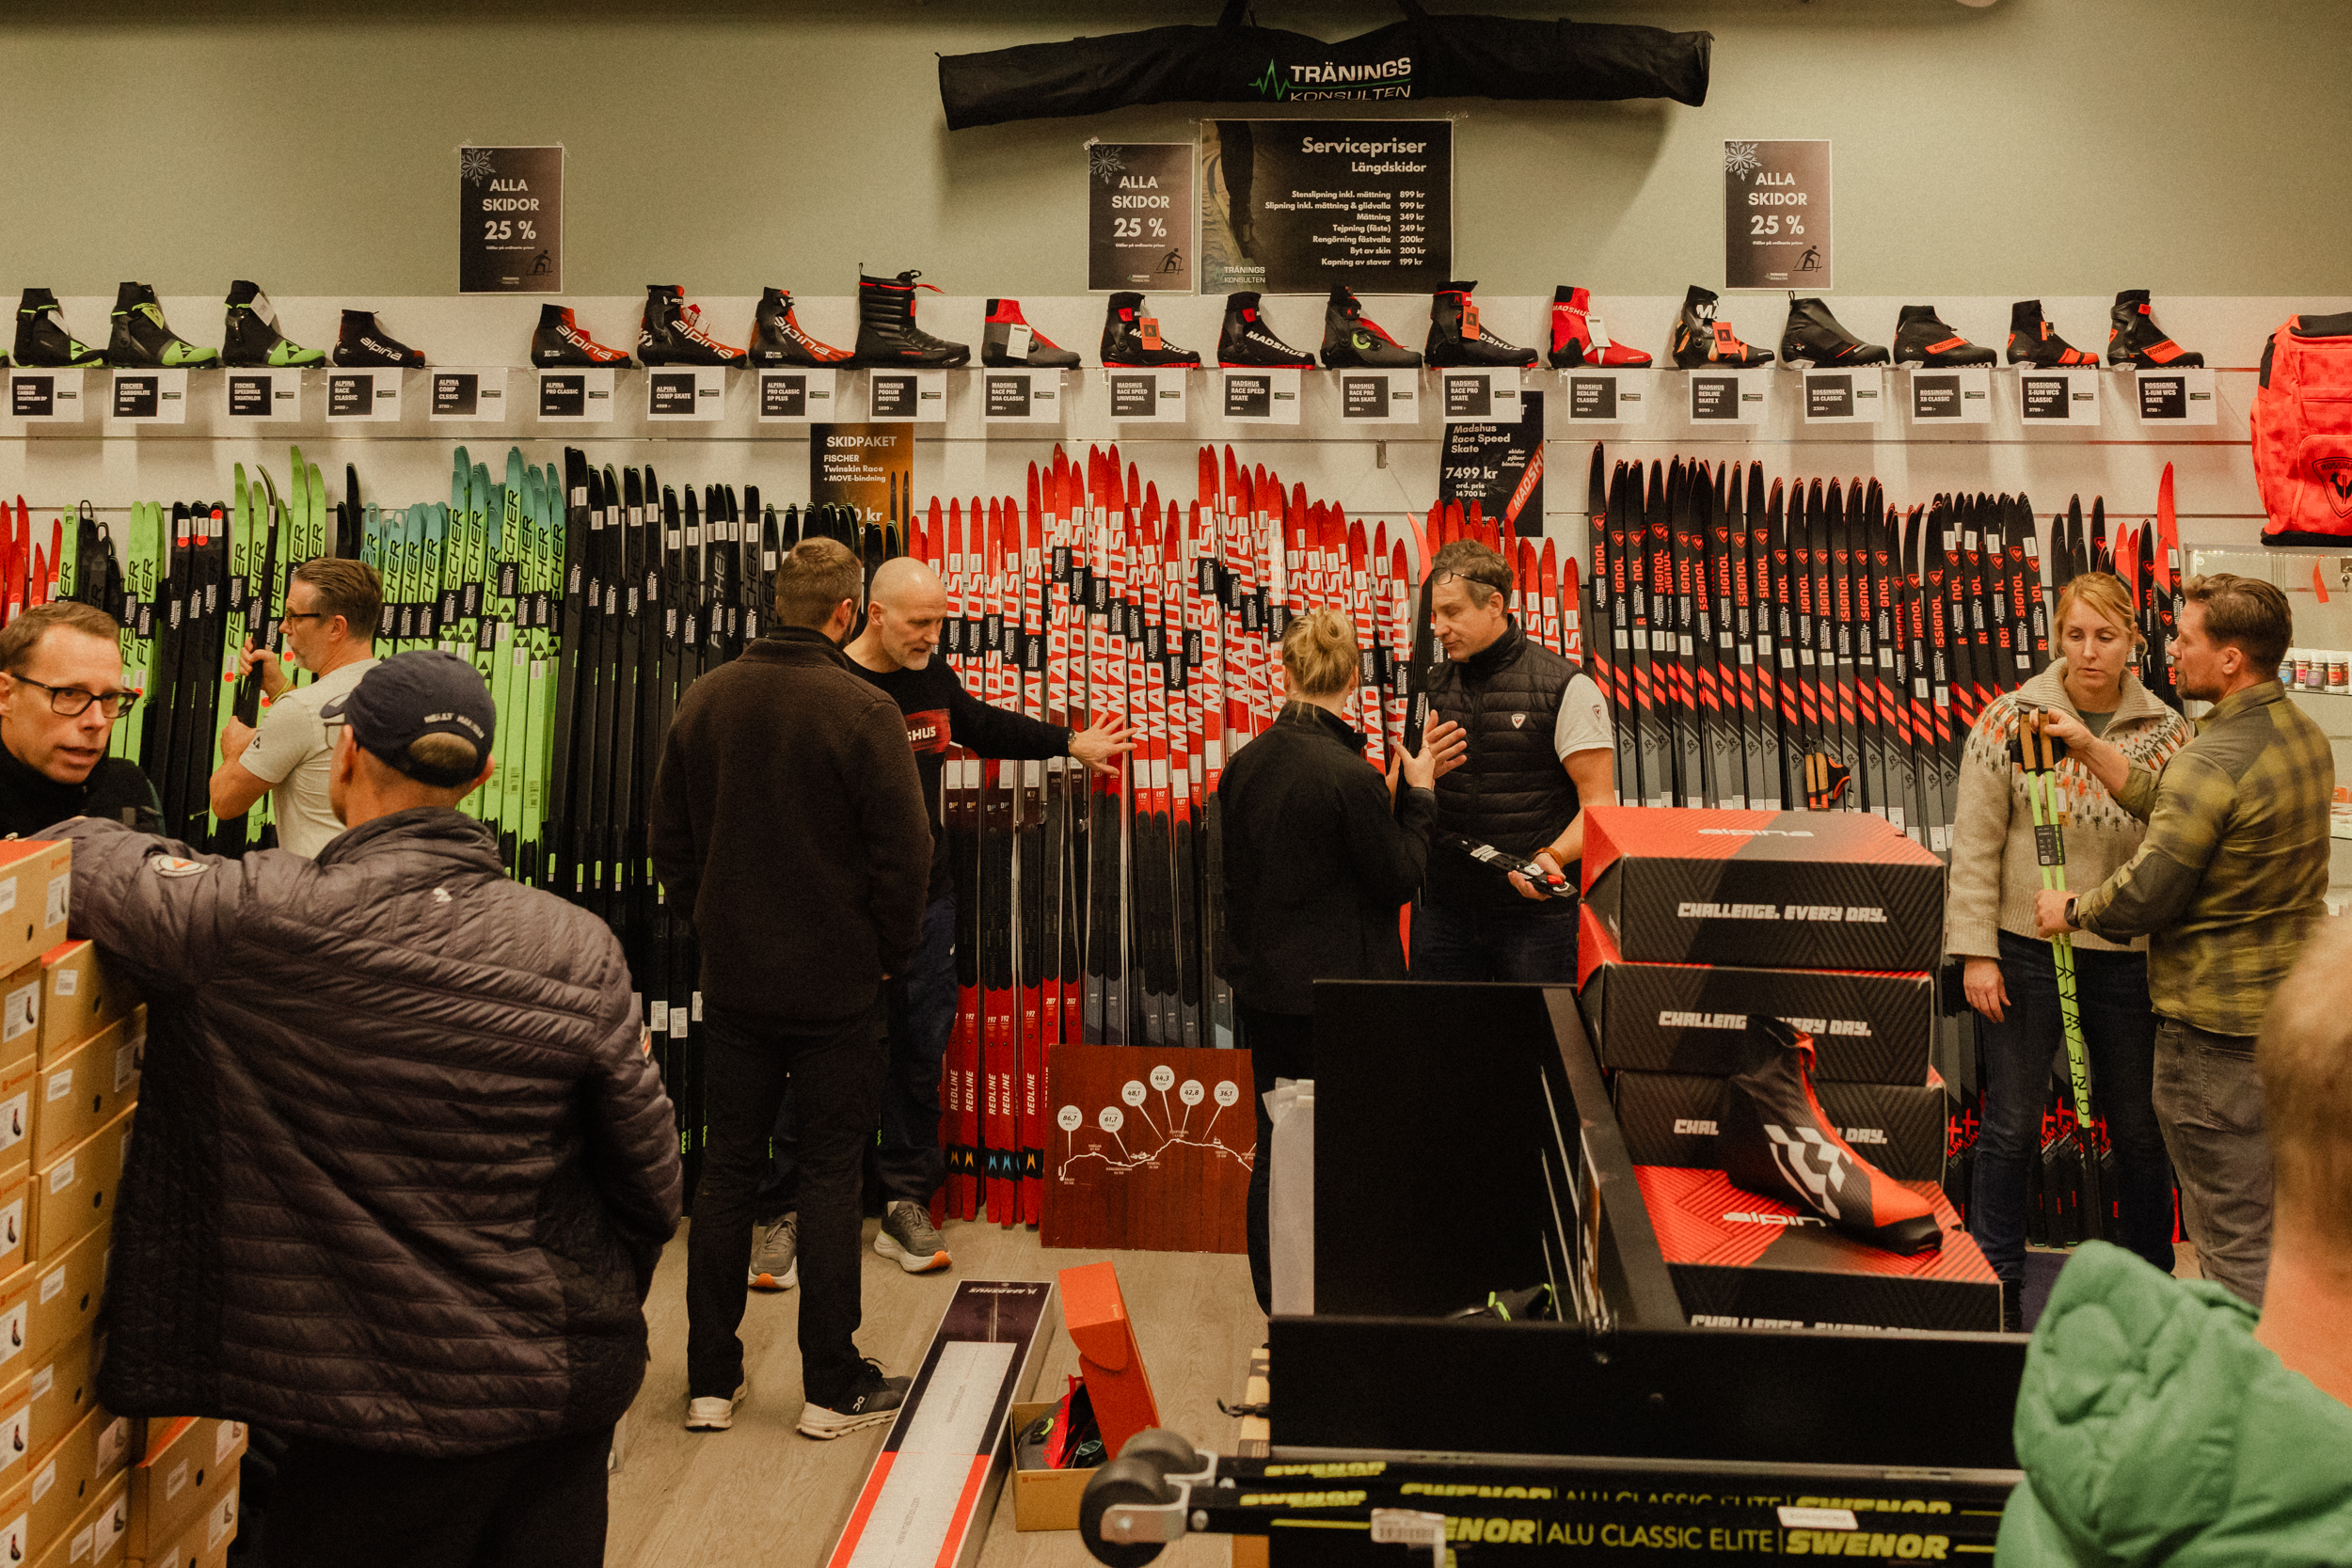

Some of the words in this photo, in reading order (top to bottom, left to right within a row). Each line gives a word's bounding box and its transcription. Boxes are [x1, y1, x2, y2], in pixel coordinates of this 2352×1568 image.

[1291, 57, 1411, 83] TRÄNINGS
[1291, 85, 1411, 102] KONSULTEN
[1301, 137, 1426, 157] Servicepriser
[1352, 162, 1426, 175] Längdskidor
[489, 180, 529, 191] ALLA
[1119, 176, 1158, 188] ALLA
[1756, 173, 1795, 185] ALLA
[1292, 191, 1337, 199] Stenslipning
[1357, 191, 1391, 199] mättning
[1748, 193, 1807, 205] SKIDOR
[483, 198, 539, 211] SKIDOR
[1112, 196, 1169, 209] SKIDOR
[1265, 202, 1295, 211] Slipning
[1314, 202, 1349, 211] mättning
[1359, 202, 1391, 211] glidvalla
[1357, 214, 1391, 222] Mättning
[485, 221, 511, 240] 25
[518, 221, 536, 239] %
[1113, 218, 1141, 237] 25
[1149, 218, 1167, 237] %
[1333, 225, 1365, 233] Tejpning
[1366, 224, 1391, 233] (fäste)
[1751, 215, 1779, 234] 25
[1787, 215, 1804, 235] %
[1313, 235, 1357, 245] Rengörning
[1350, 247, 1362, 256] Byt
[1322, 258, 1354, 267] Kapning
[1224, 265, 1265, 274] TRÄNINGS
[672, 320, 734, 359] alpina
[774, 316, 831, 356] alpina
[359, 337, 403, 361] alpina
[556, 325, 612, 361] alpina
[1246, 330, 1307, 358] MADSHUS
[1454, 423, 1497, 434] Madshus
[826, 436, 897, 447] SKIDPAKET
[1453, 435, 1475, 443] Race
[1477, 434, 1510, 445] Speed
[1451, 445, 1479, 453] Skate
[1445, 467, 1480, 479] 7499
[1484, 466, 1498, 479] kr
[1471, 483, 1485, 491] pris
[448, 509, 463, 590] SCHER
[2012, 572, 2026, 618] SIGNOL
[907, 726, 936, 741] SHUS
[1698, 828, 1814, 837] alpina
[1677, 902, 1780, 919] CHALLENGE.
[1784, 905, 1843, 921] EVERY
[1845, 907, 1887, 923] DAY.
[1658, 1010, 1747, 1030] CHALLENG
[1829, 1020, 1872, 1037] DAY.
[1002, 1073, 1010, 1116] REDLINE
[1723, 1212, 1826, 1227] alpin
[1444, 1516, 1536, 1544] ENOR
[1547, 1524, 1595, 1546] ALU
[1600, 1523, 1702, 1551] CLASSIC
[1710, 1528, 1772, 1553] ELITE
[1786, 1531, 1950, 1560] SWENOR
